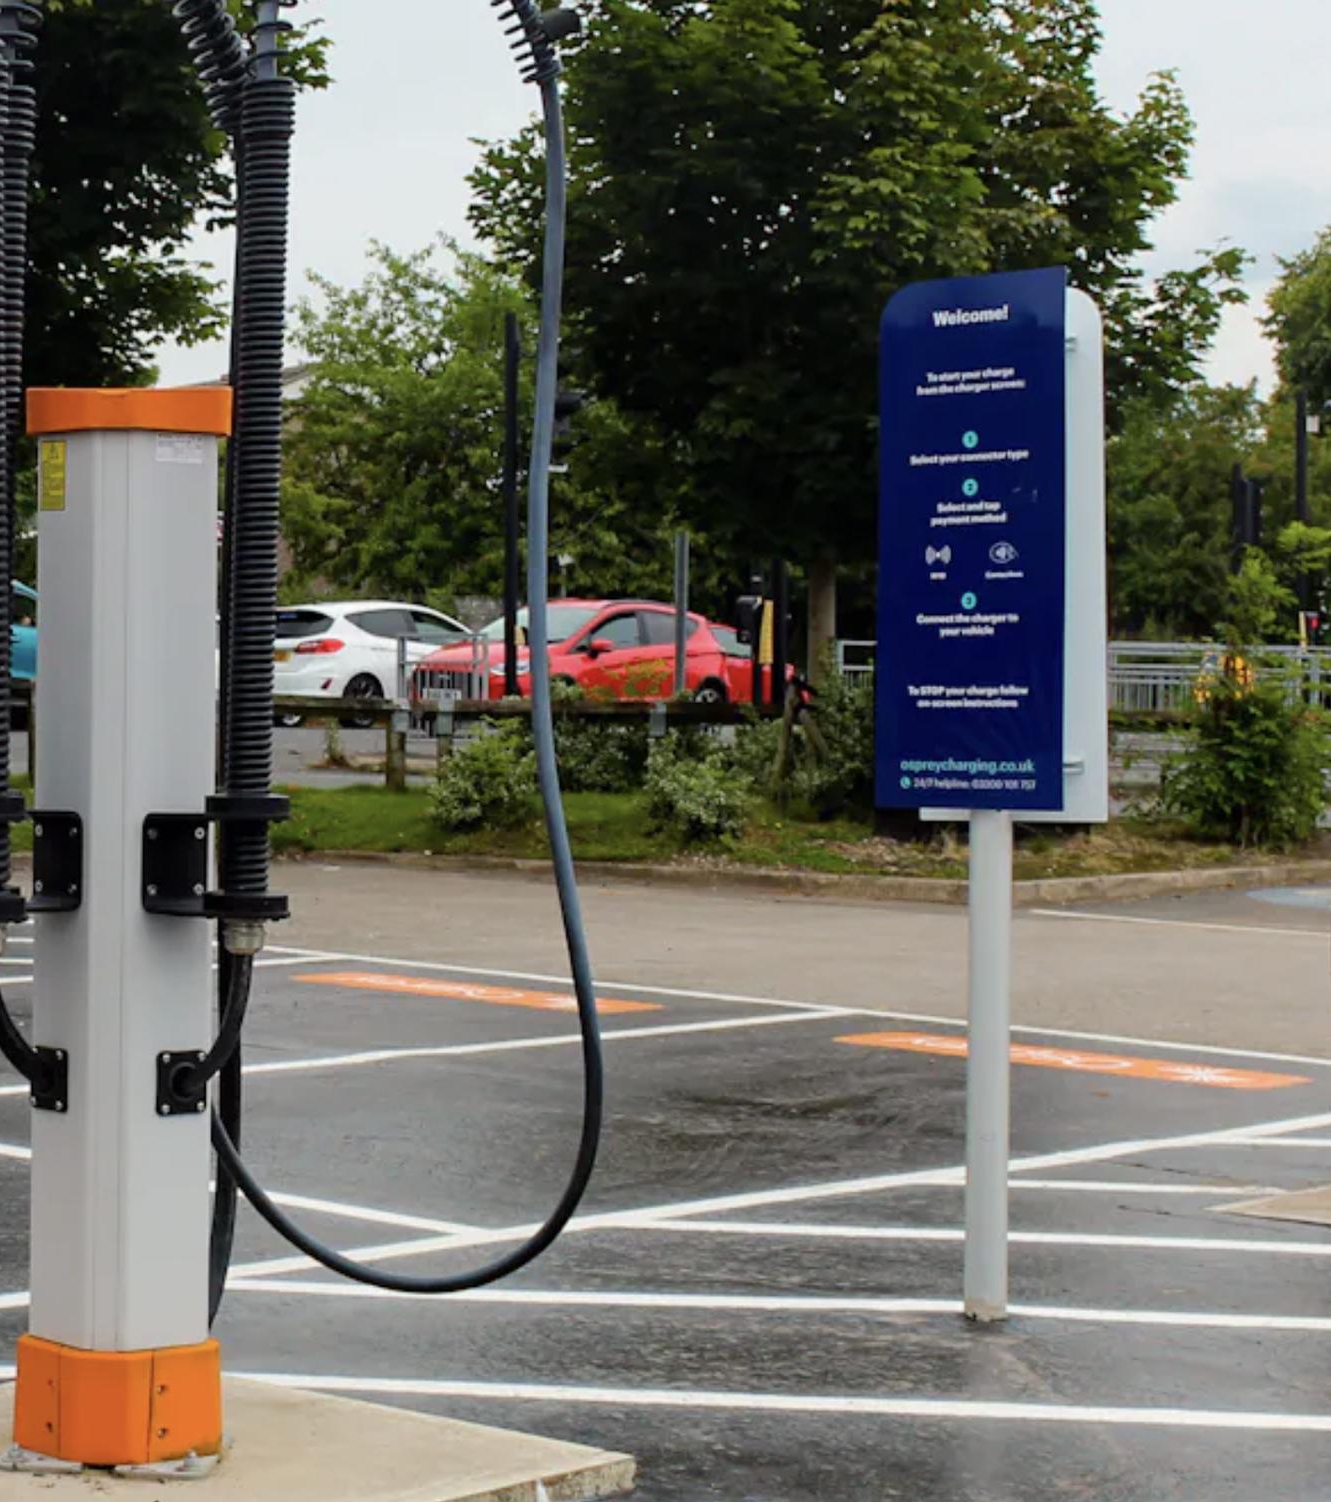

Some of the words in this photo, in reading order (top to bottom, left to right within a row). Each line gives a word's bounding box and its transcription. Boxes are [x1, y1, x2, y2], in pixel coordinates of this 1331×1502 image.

[932, 303, 1009, 328] Welcome!
[926, 372, 938, 383] To
[938, 371, 960, 383] start
[961, 370, 981, 382] your
[982, 367, 1015, 379] charge
[916, 385, 938, 396] from
[939, 383, 954, 394] the
[955, 382, 990, 393] charger
[909, 453, 938, 466] Select
[938, 454, 959, 465] your
[960, 450, 1006, 462] connector
[1007, 449, 1029, 461] type
[936, 502, 965, 513] Select
[966, 500, 983, 512] and
[984, 501, 1001, 512] tap
[930, 516, 969, 528] payment
[970, 511, 1007, 523] method
[916, 613, 954, 624] Connect
[954, 613, 970, 623] the
[970, 613, 1006, 625] charger
[1006, 613, 1020, 623] to
[939, 627, 960, 638] your
[961, 625, 995, 635] vehicle
[907, 685, 919, 696] To
[920, 685, 945, 696] STOP
[945, 687, 965, 698] your
[966, 685, 999, 697] charge
[1000, 684, 1029, 695] follow
[963, 697, 1019, 708] instructions
[900, 757, 1035, 775] ospreycharging.co.uk
